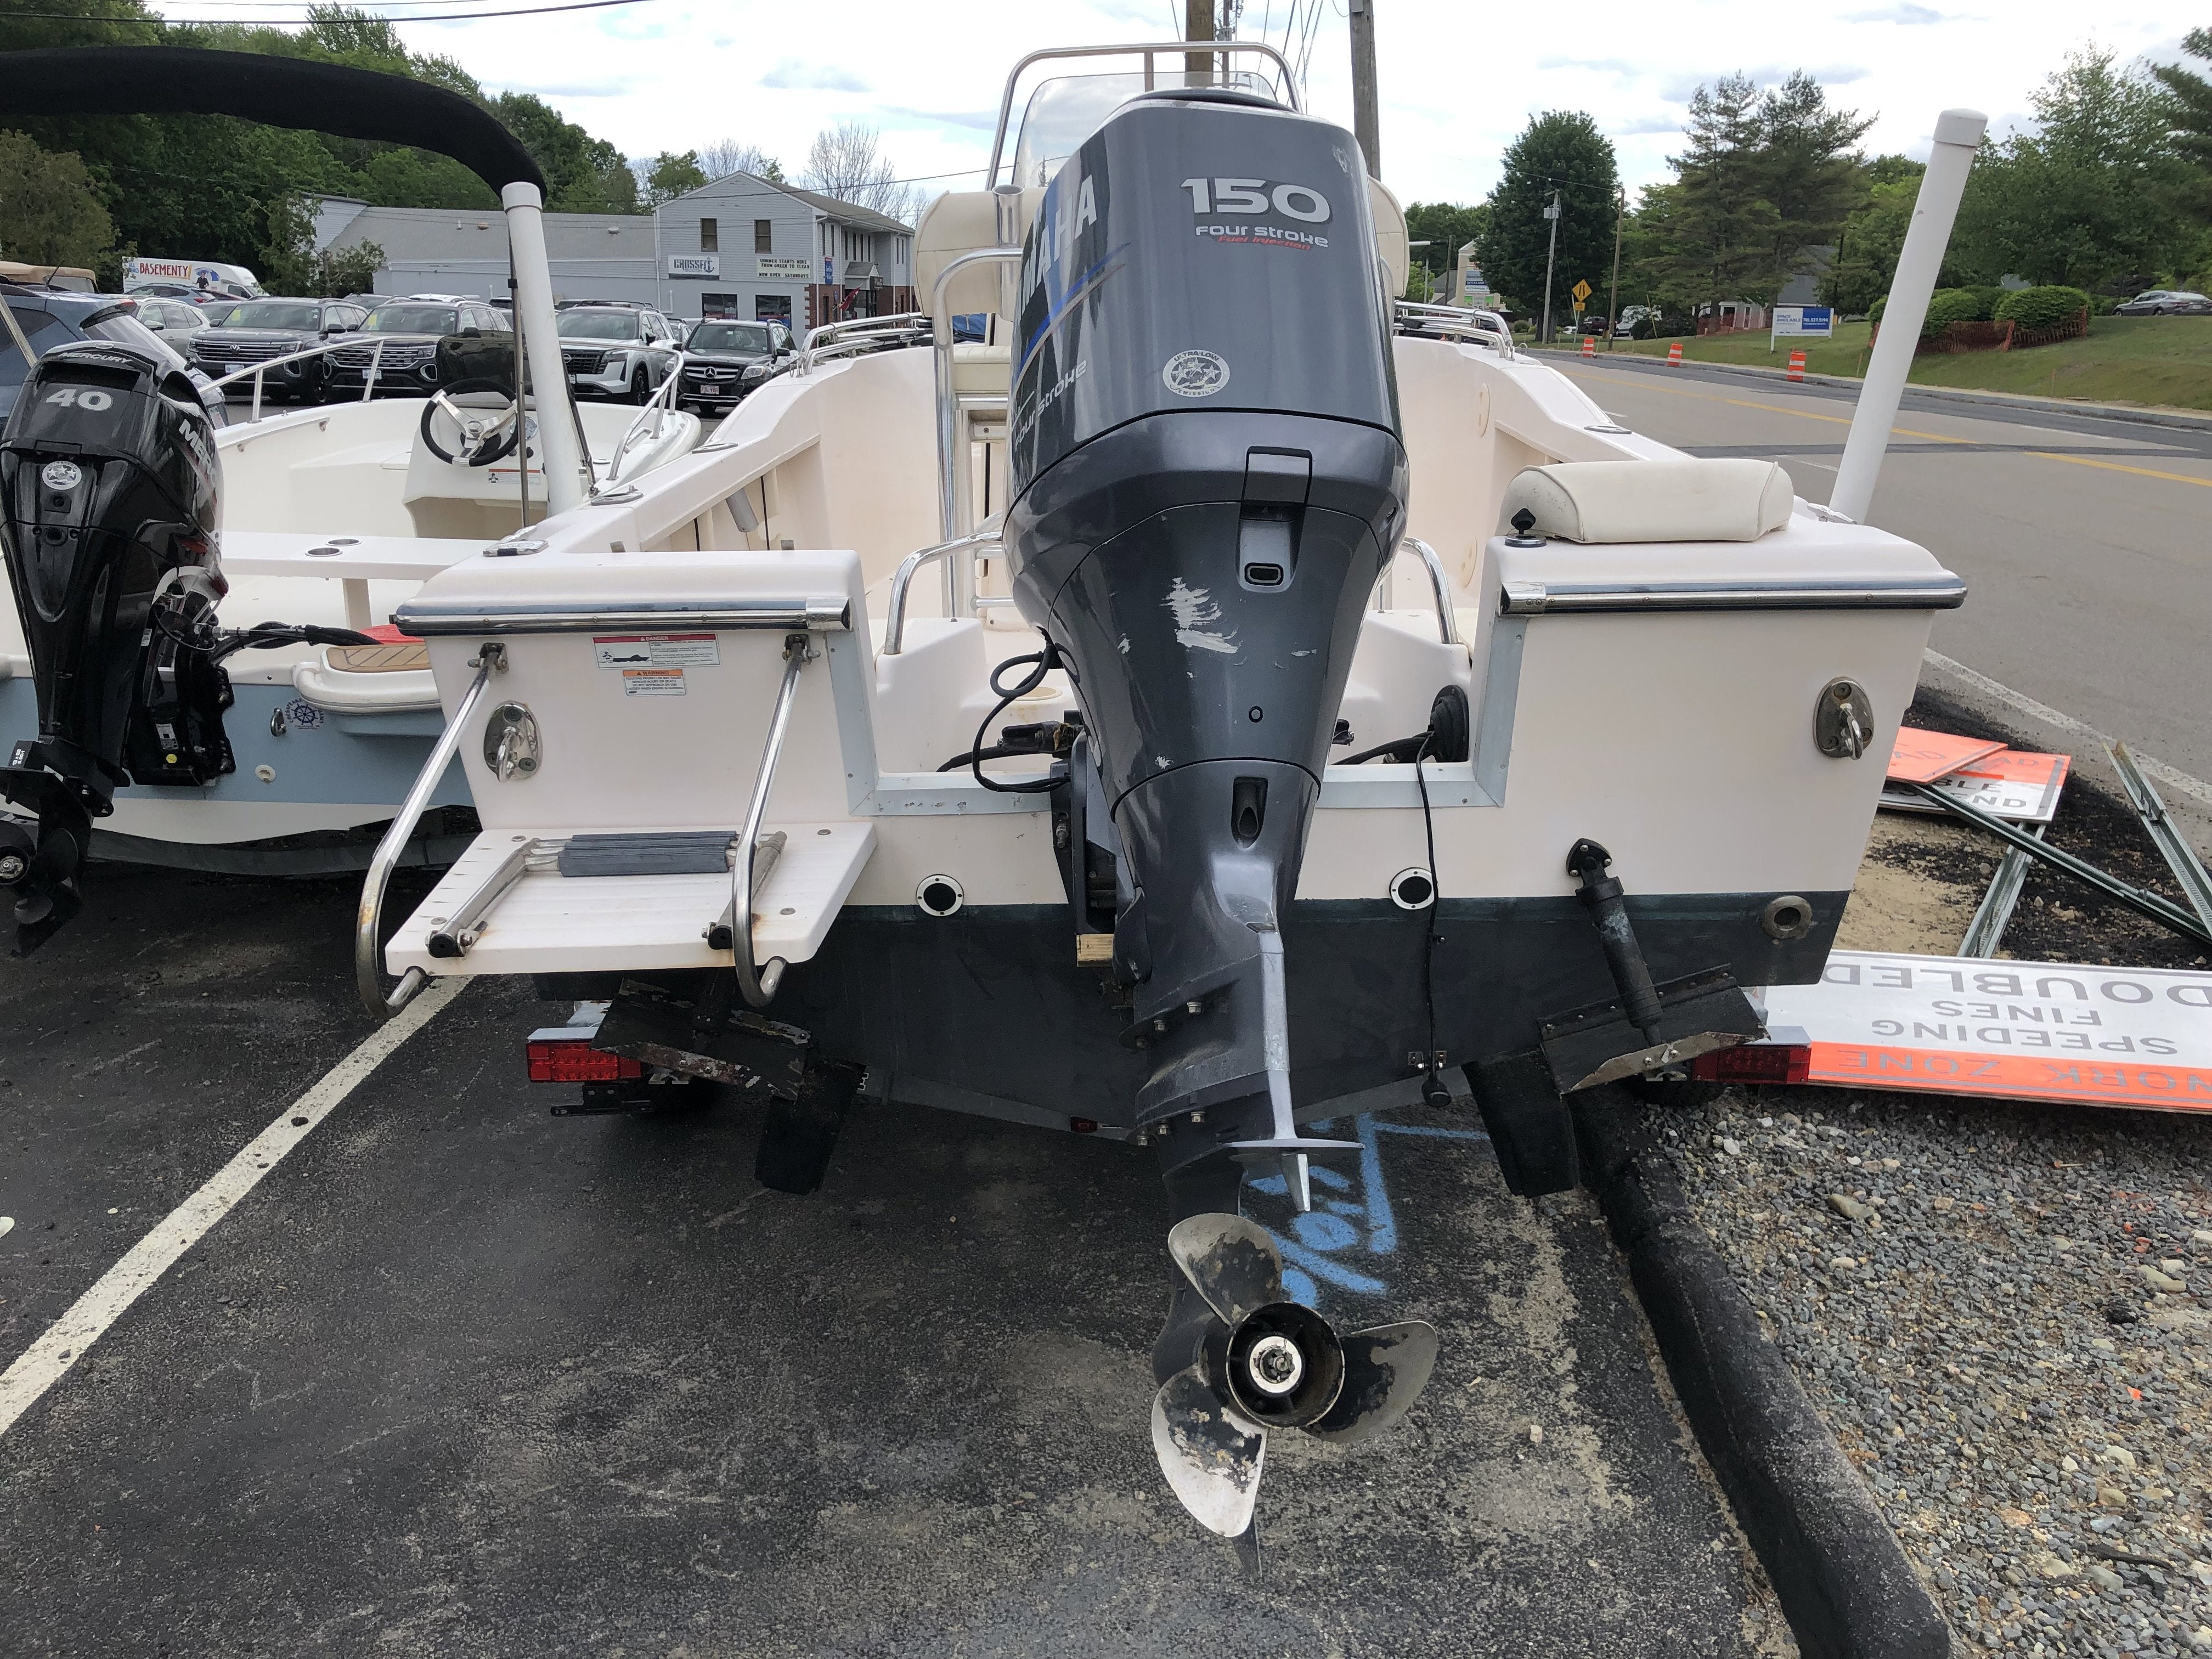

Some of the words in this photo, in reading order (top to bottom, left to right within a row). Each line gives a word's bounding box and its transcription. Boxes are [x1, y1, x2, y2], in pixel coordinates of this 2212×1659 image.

[1180, 178, 1330, 223] 150
[1014, 174, 1097, 324] MAHA
[58, 353, 133, 364] MERCURY
[46, 388, 113, 411] 40
[1932, 778, 2003, 793] BLE
[1821, 963, 2212, 1008] DOUBLED
[1931, 1000, 2102, 1026] FINES
[1871, 1019, 2177, 1056] SPEEDING
[1837, 1049, 2001, 1078] ZONE
